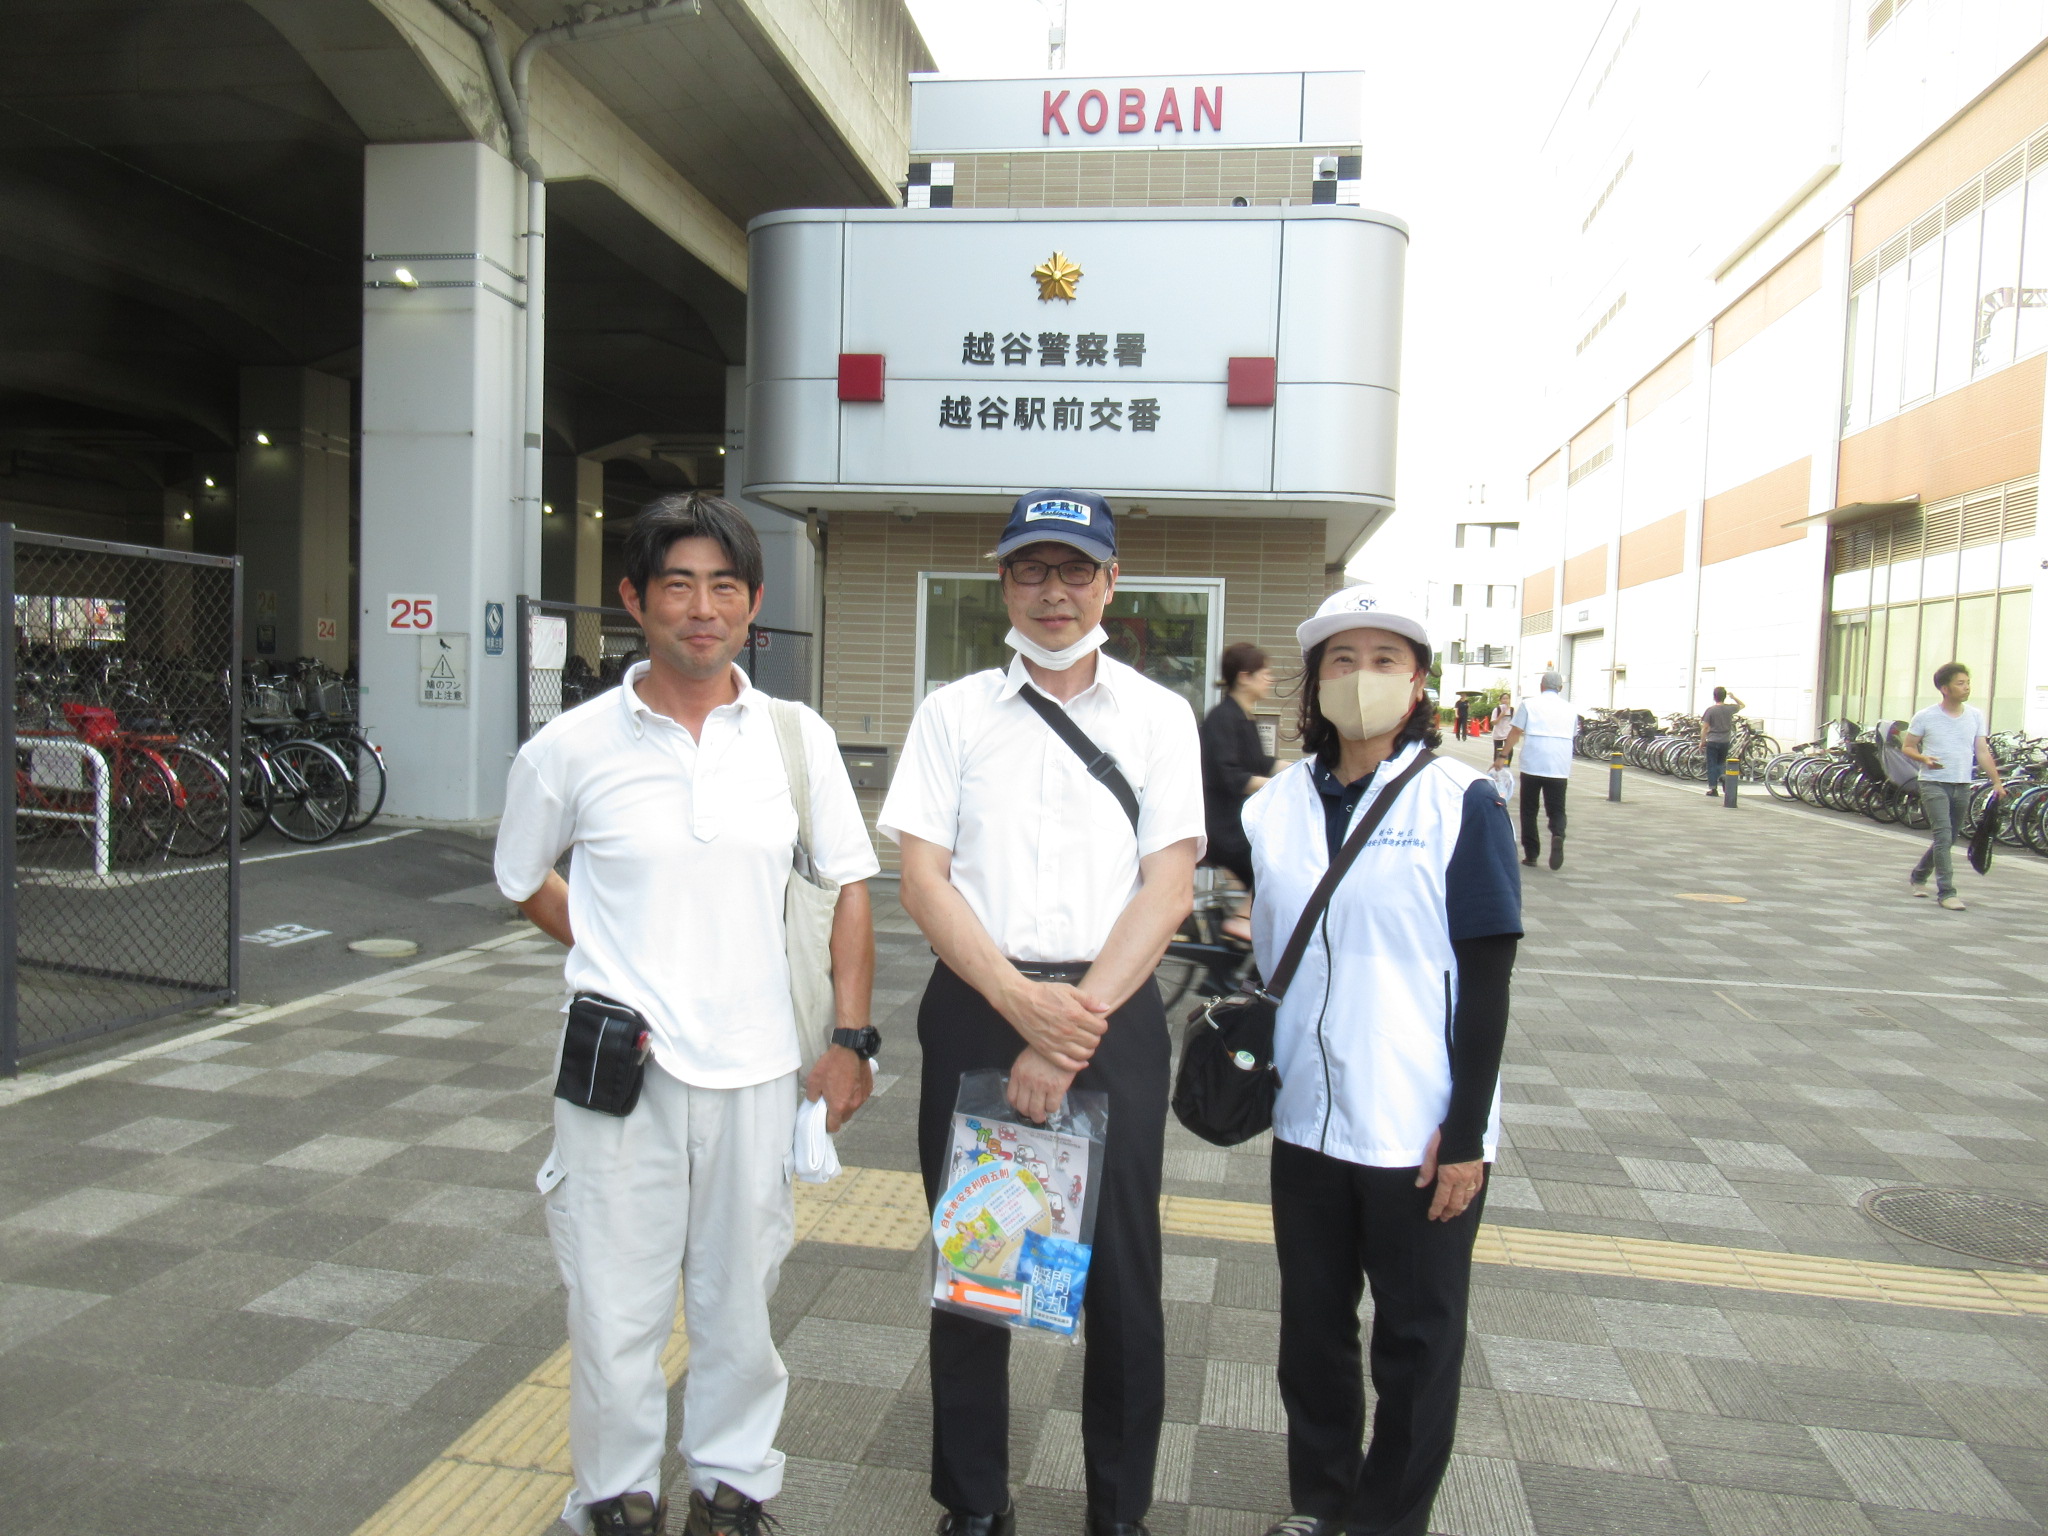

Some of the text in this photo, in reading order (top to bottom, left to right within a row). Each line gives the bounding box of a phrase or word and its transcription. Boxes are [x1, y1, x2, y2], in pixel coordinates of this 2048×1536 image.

[1042, 86, 1223, 135] KOBAN
[962, 332, 1147, 367] 越谷警察署
[939, 395, 1161, 432] 越谷駅前交番
[319, 621, 335, 638] 24
[390, 599, 433, 629] 25
[424, 690, 463, 701] 頭上注意
[426, 680, 461, 690] 鳩のフン
[941, 1168, 1010, 1229] 自転車安全利用五則
